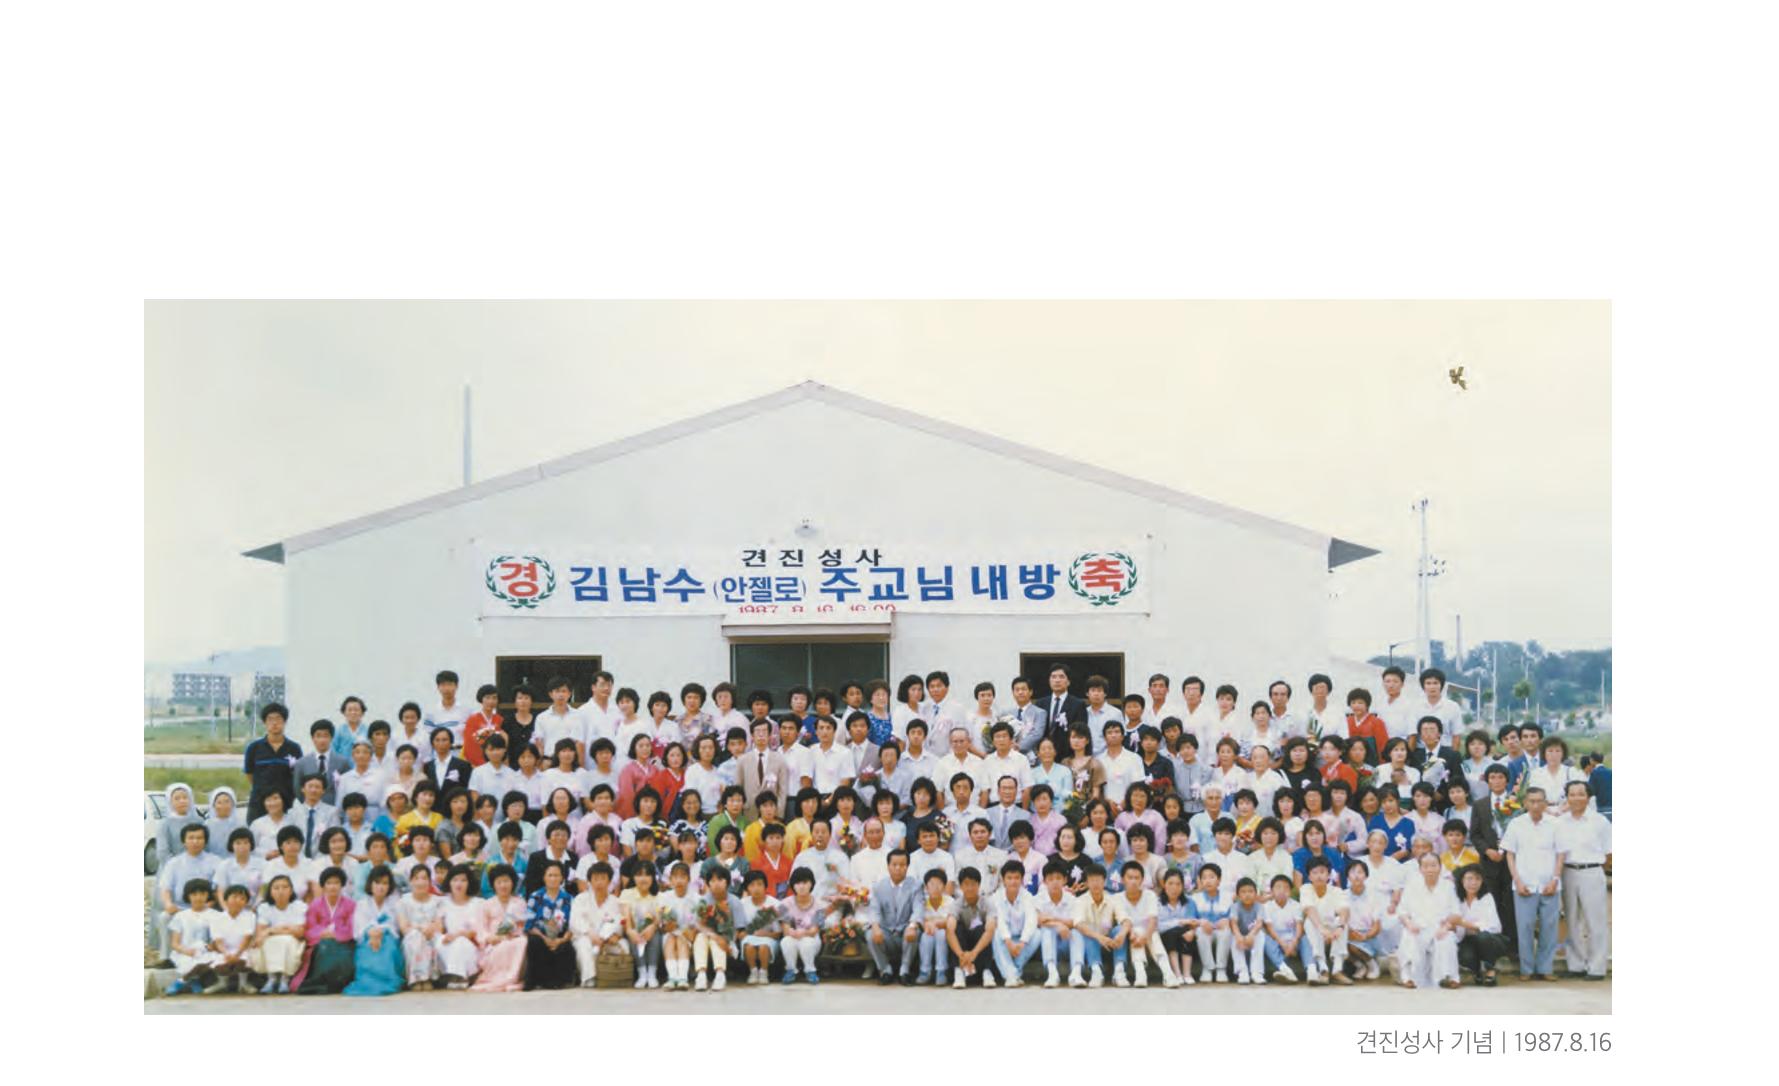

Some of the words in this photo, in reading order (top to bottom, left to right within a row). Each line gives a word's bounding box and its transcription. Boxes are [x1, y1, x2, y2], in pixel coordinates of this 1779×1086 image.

[500, 562, 539, 597] 경
[570, 566, 705, 603] 김남수
[713, 575, 806, 604] (안젤로)
[819, 565, 954, 602] 주교님
[971, 564, 1061, 601] 내방
[1080, 559, 1124, 592] 축
